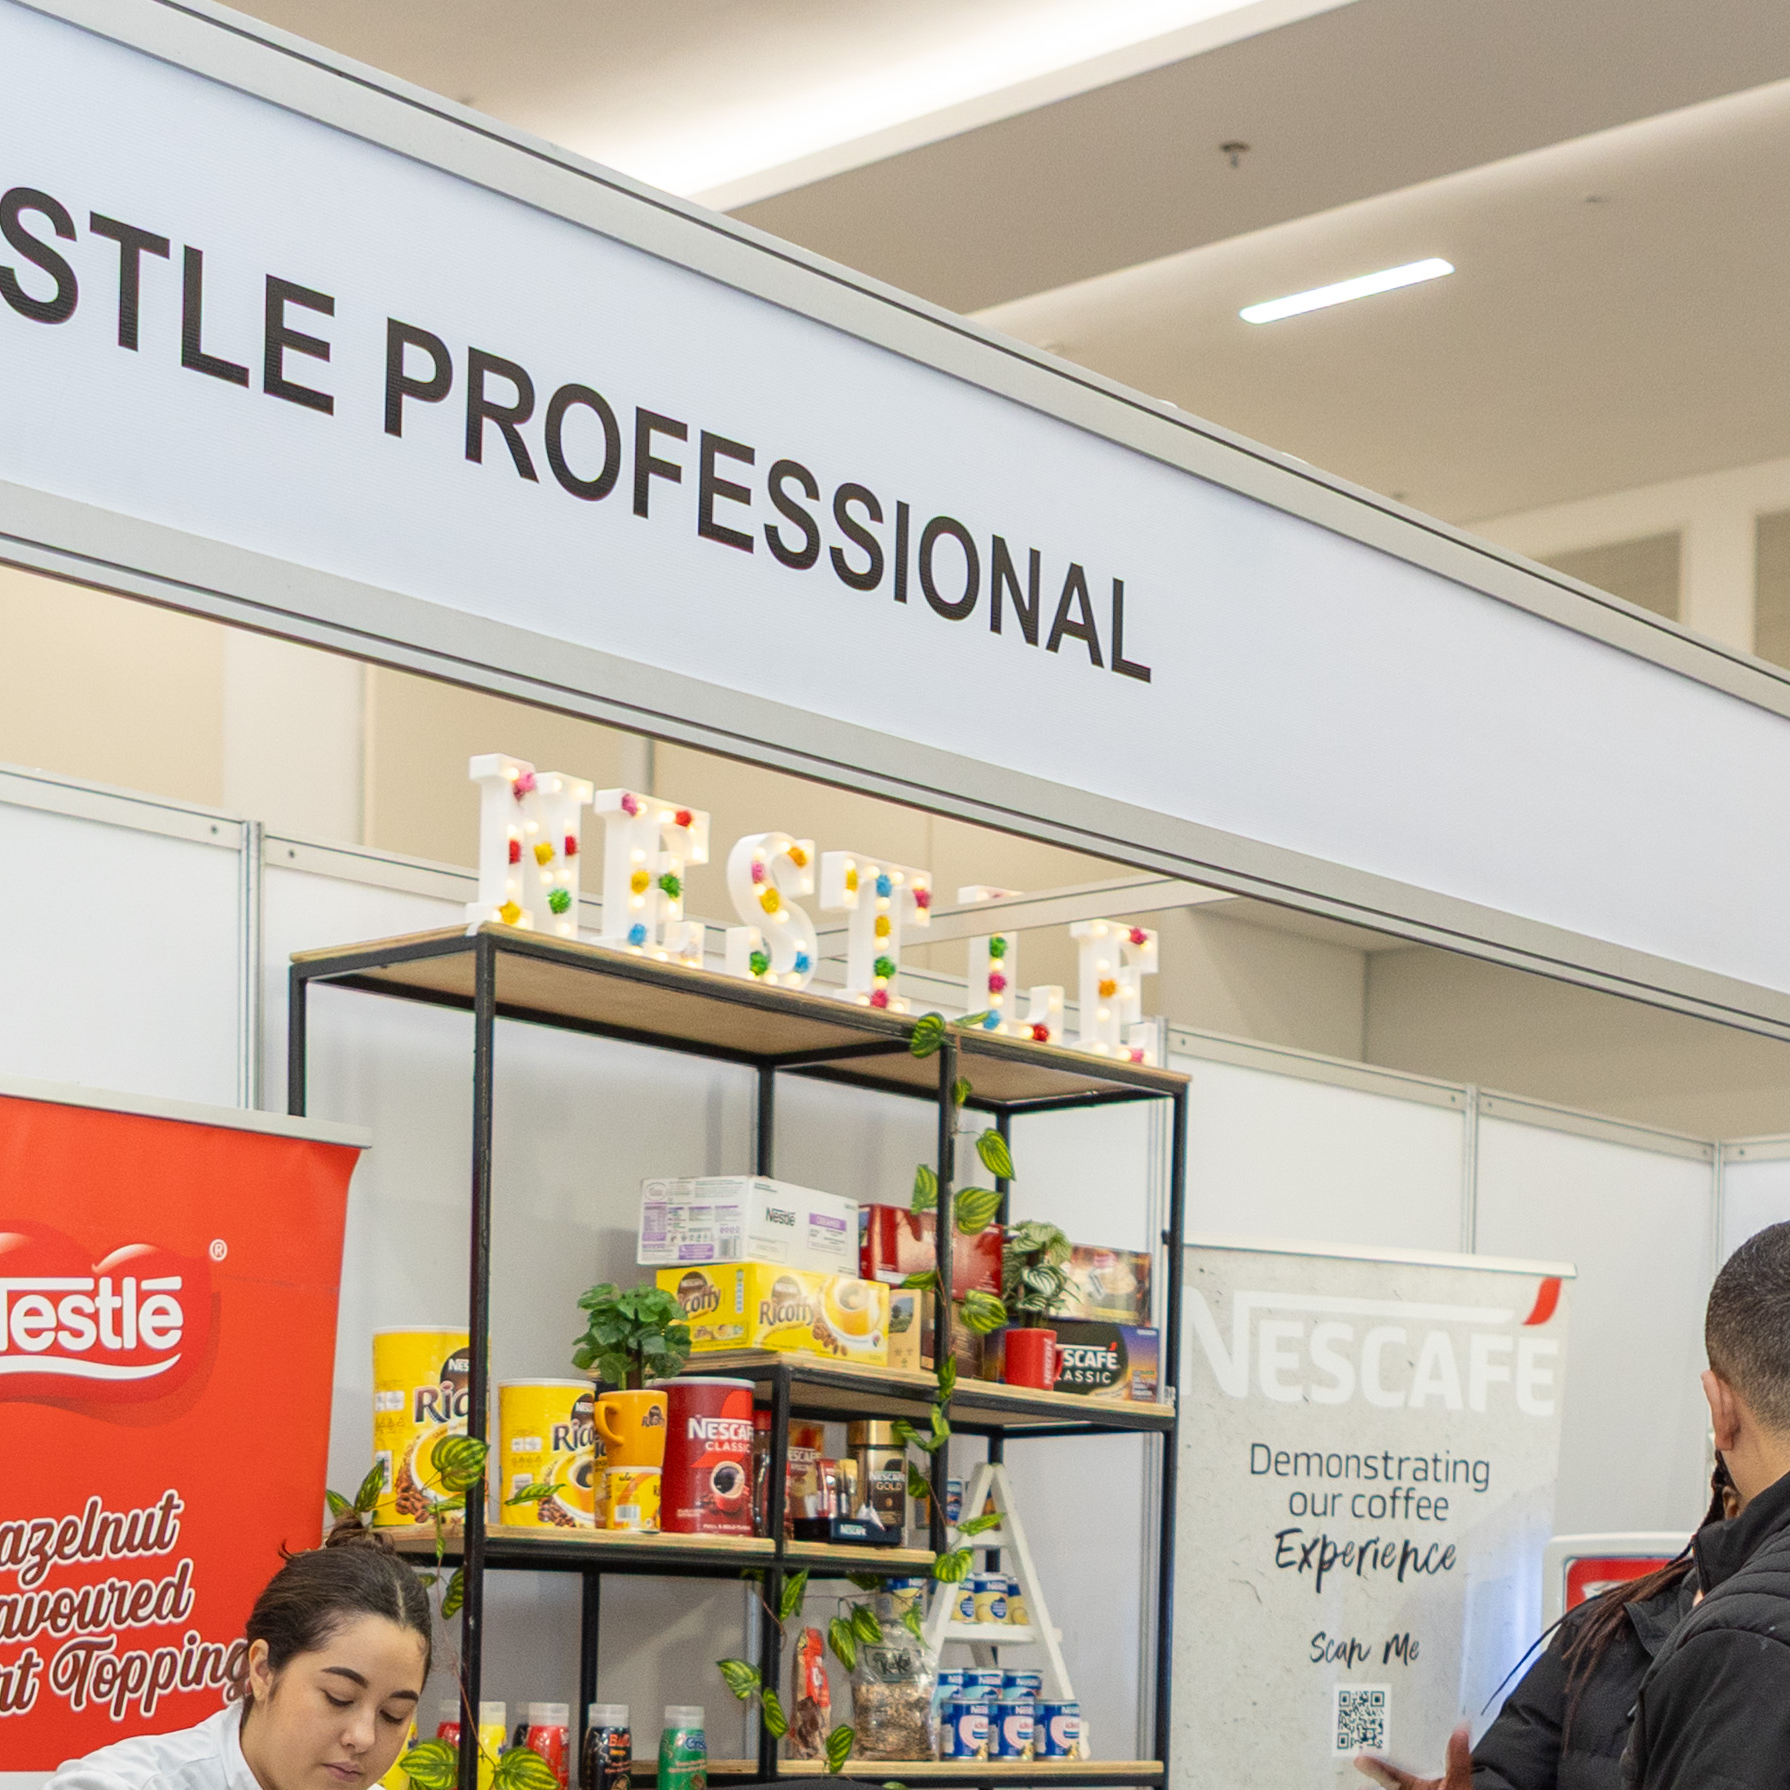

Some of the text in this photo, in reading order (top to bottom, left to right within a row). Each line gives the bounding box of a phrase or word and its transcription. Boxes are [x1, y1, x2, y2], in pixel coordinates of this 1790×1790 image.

[383, 317, 1153, 684] PROFESSIONAL
[766, 1207, 796, 1226] Nestlé
[679, 1284, 721, 1313] coffy
[1063, 1342, 1118, 1369] SCAFÉ
[1181, 1277, 1562, 1417] NESCAFÉ
[1060, 1370, 1111, 1384] ASSIC
[688, 1417, 755, 1442] NESCAF
[1250, 1442, 1491, 1493] Demonstrating
[875, 1481, 903, 1491] GOLD
[1289, 1487, 1450, 1522] our coffee
[1275, 1528, 1457, 1593] Experience
[1310, 1632, 1420, 1668] Scan Me
[52, 1631, 251, 1722] Topping
